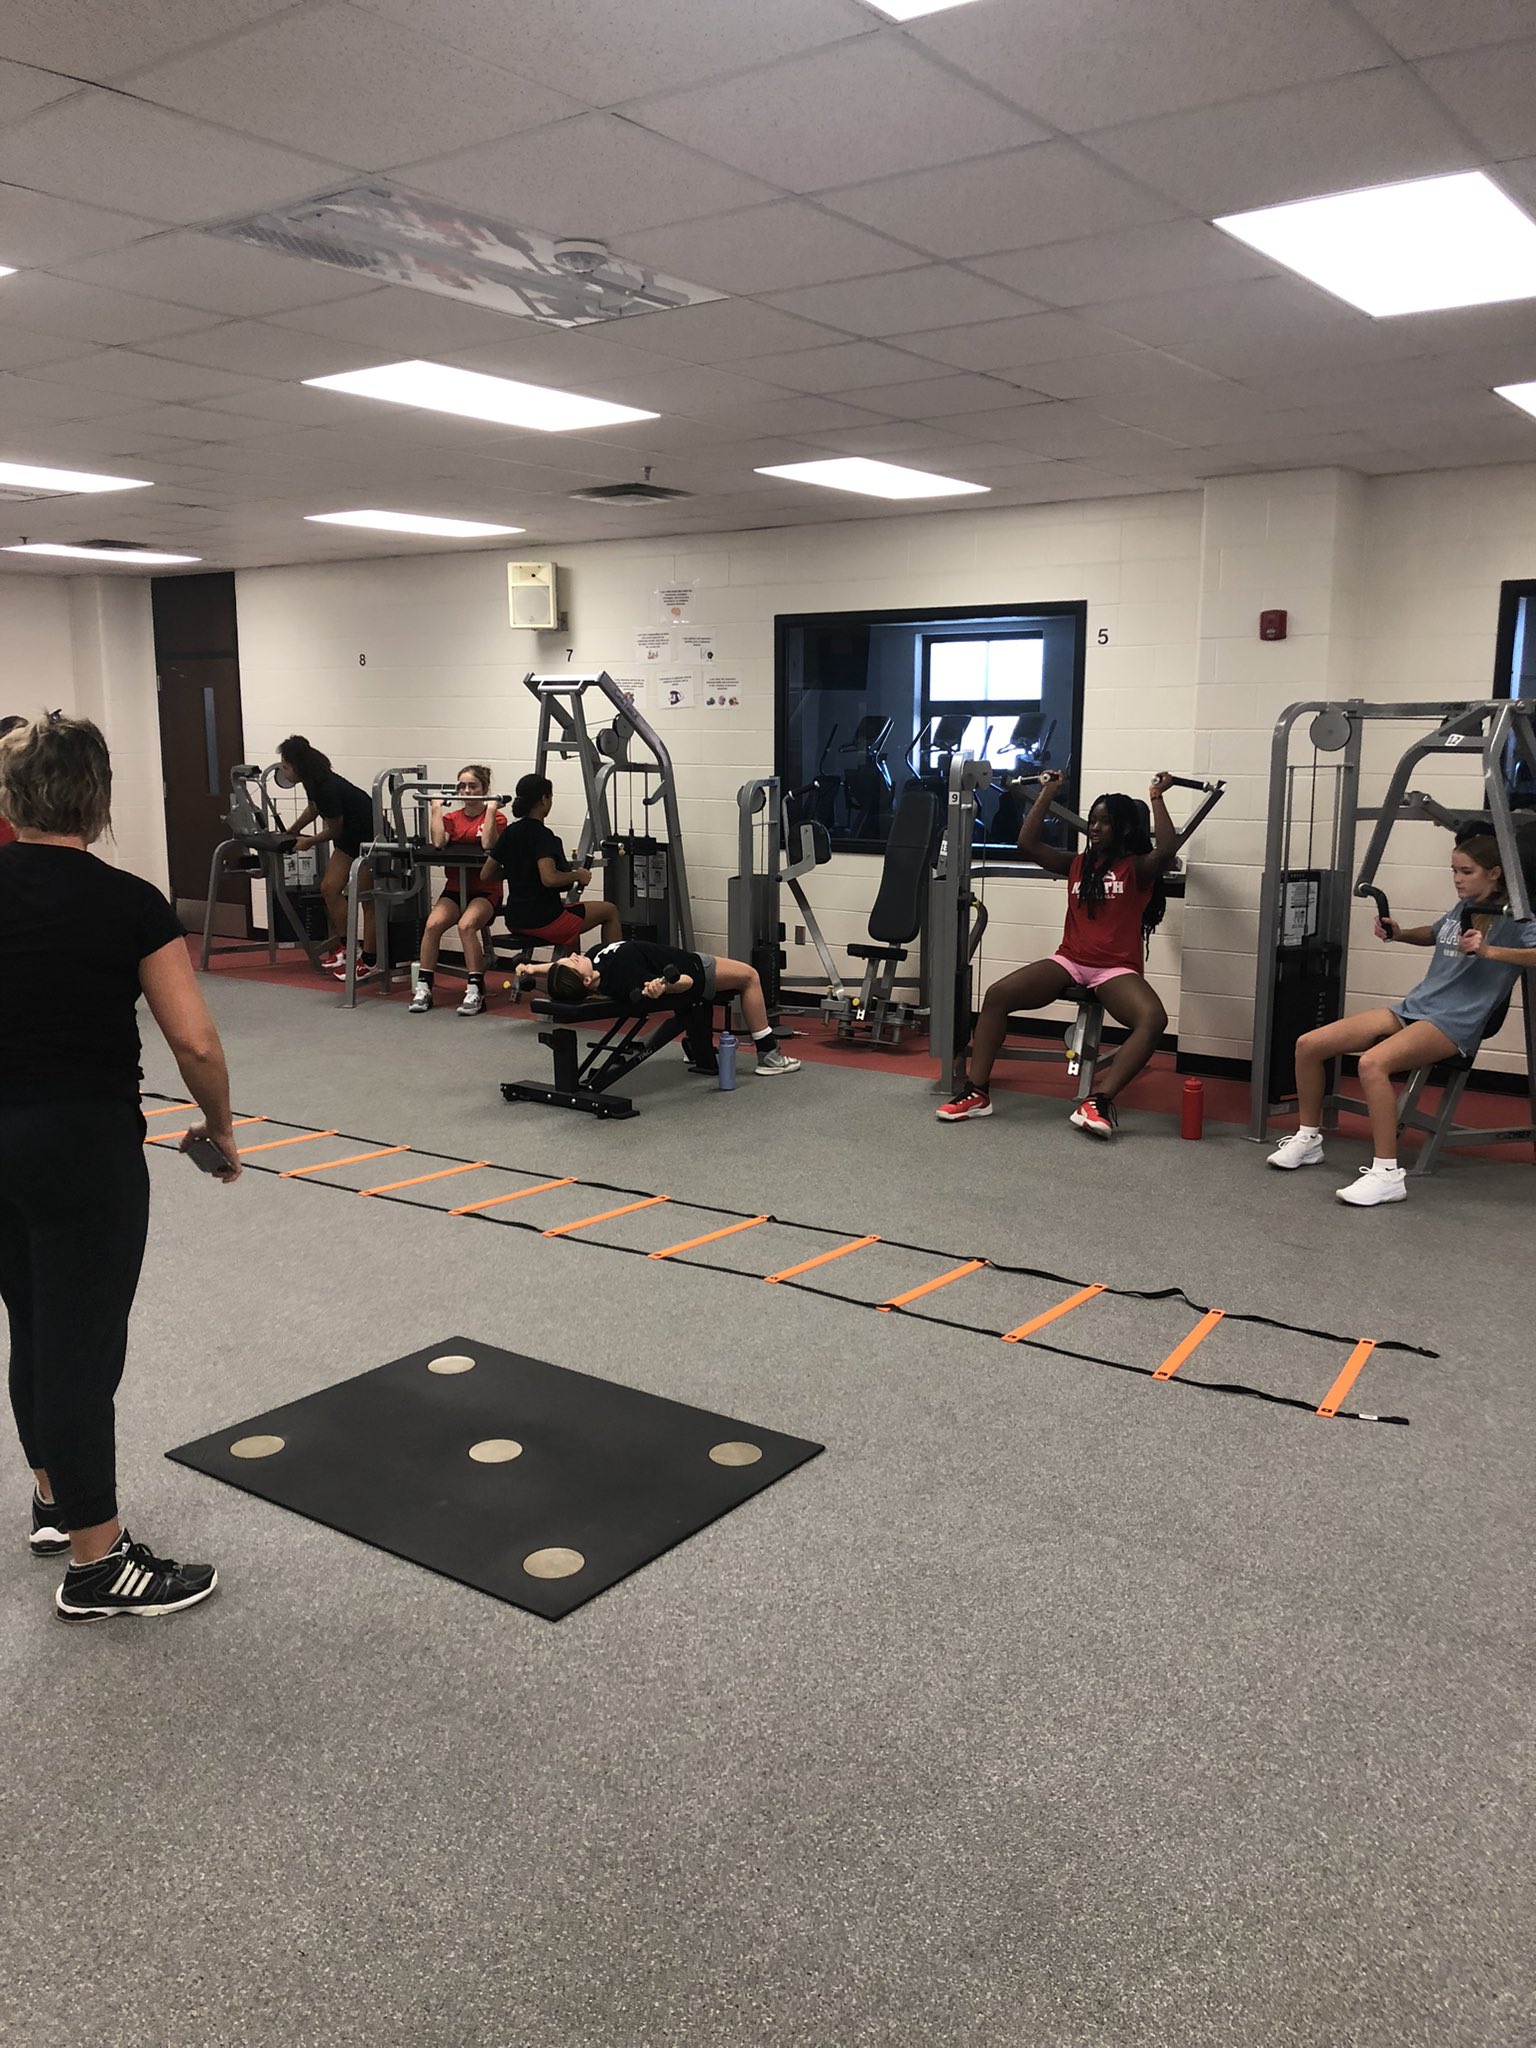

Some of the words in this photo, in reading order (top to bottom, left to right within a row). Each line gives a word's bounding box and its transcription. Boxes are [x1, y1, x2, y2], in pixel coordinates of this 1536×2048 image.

[1097, 628, 1109, 645] 5
[359, 653, 366, 666] 8
[566, 649, 573, 662] 7
[951, 793, 959, 803] 9
[1071, 881, 1124, 894] NTH
